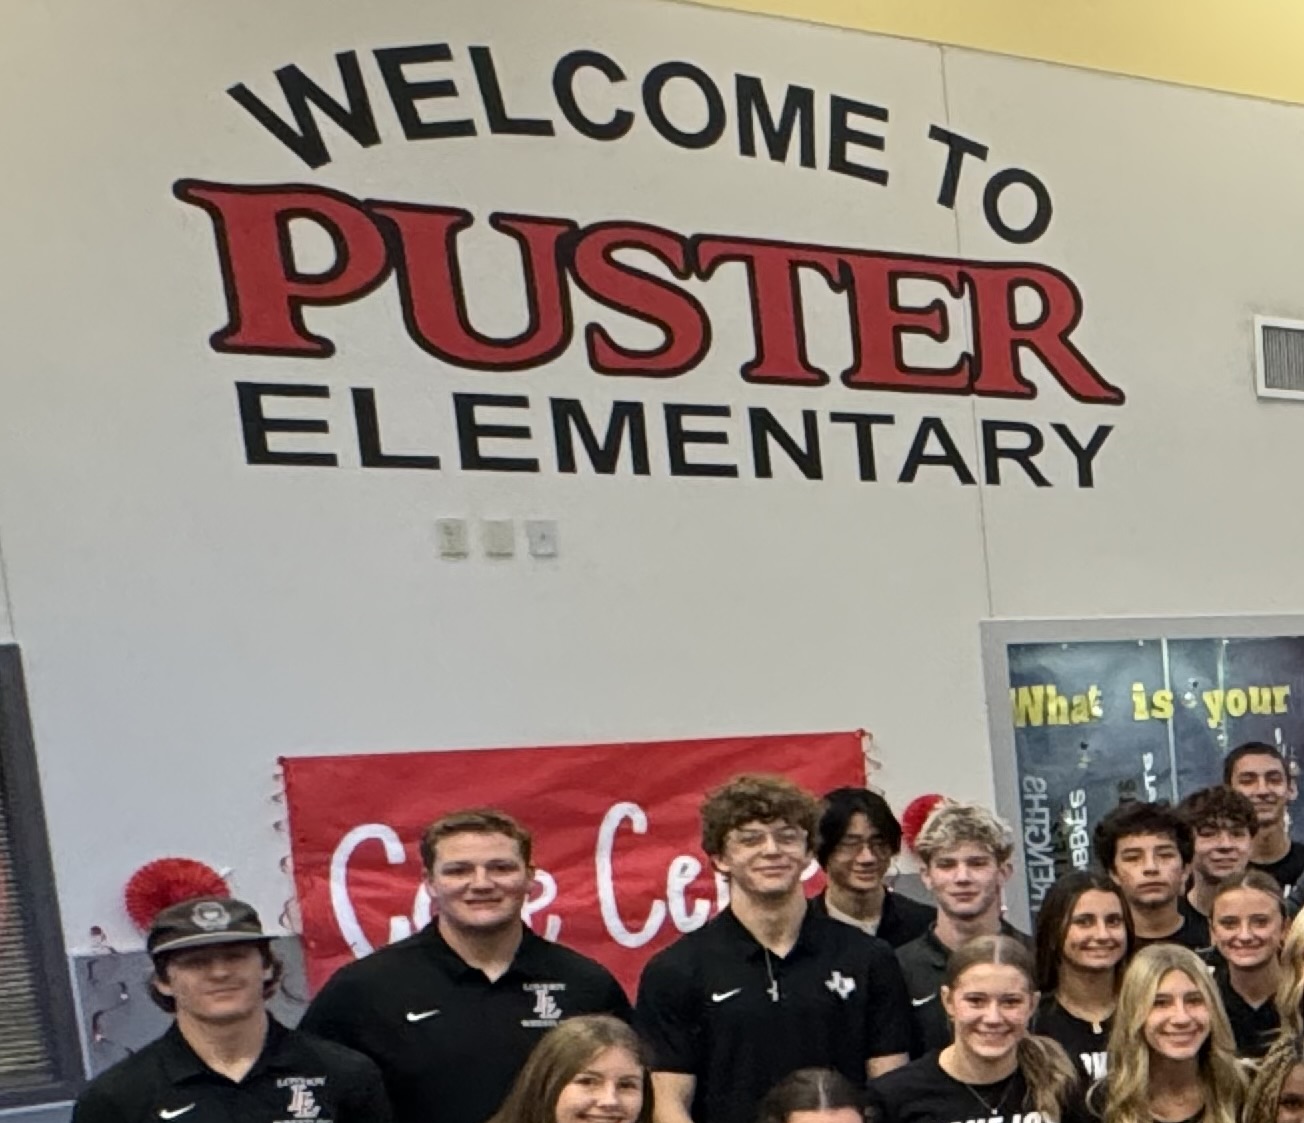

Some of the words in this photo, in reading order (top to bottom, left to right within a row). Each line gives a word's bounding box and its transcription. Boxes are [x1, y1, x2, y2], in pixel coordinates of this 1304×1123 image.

[226, 43, 890, 186] WELCOME
[926, 123, 1055, 245] TO
[173, 178, 1126, 404] PUSTER
[235, 380, 1115, 489] ELEMENTARY
[1009, 684, 1104, 728] What
[1132, 682, 1174, 721] is
[1202, 684, 1291, 729] your
